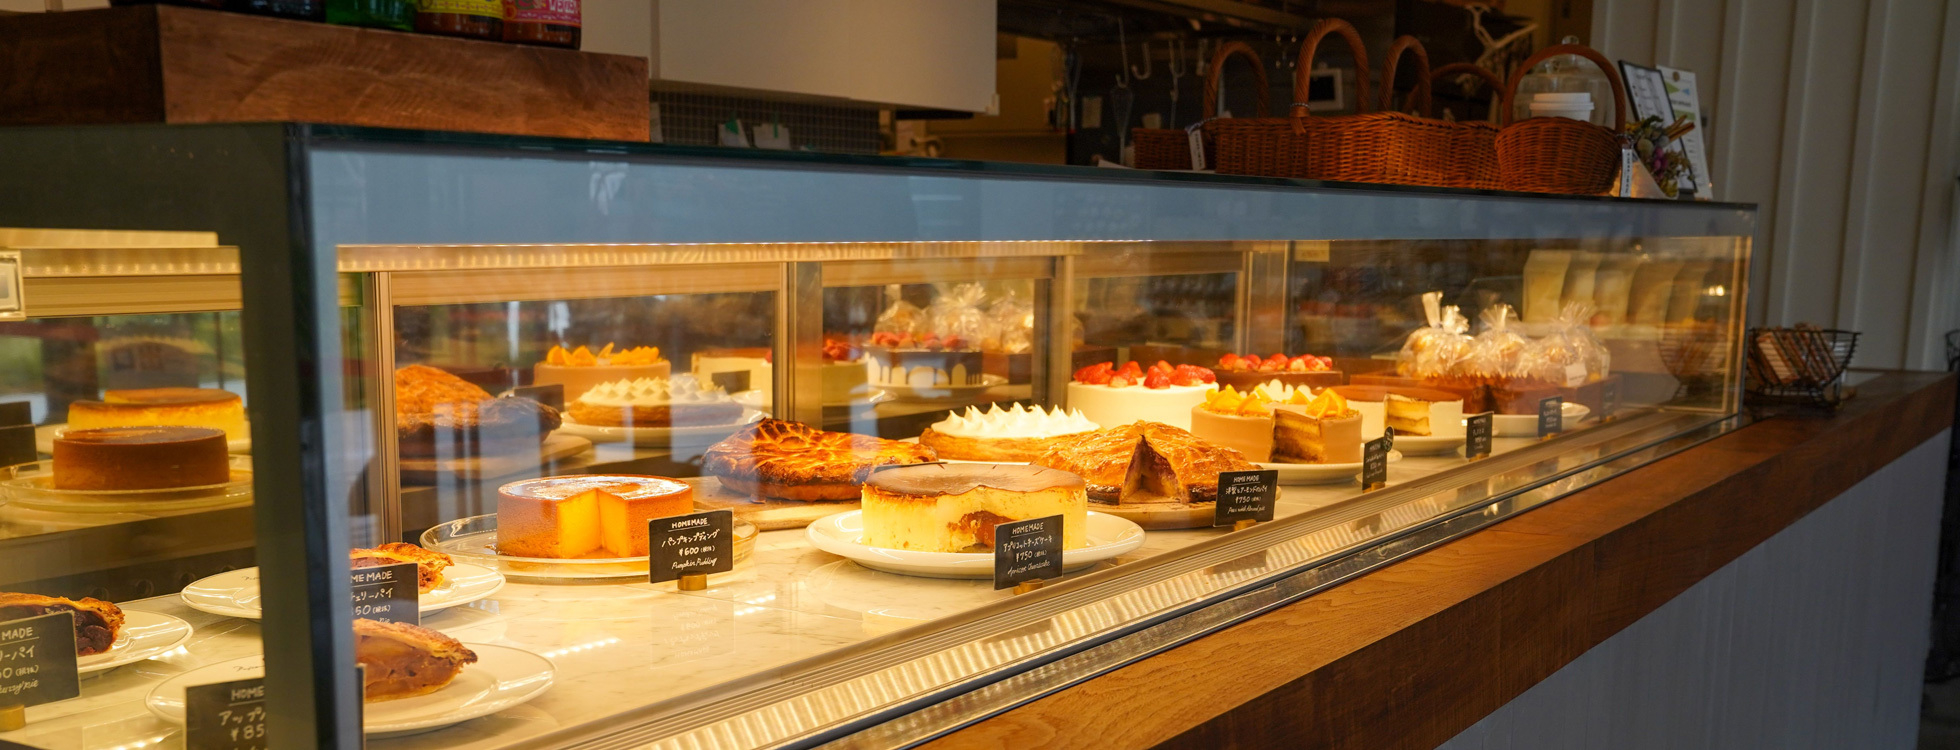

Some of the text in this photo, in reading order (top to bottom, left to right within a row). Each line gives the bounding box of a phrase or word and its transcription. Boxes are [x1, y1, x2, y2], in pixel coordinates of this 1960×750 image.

[678, 546, 699, 557] ¥600
[1015, 550, 1033, 563] ¥750
[366, 570, 393, 582] MADE
[1, 626, 34, 641] MADE
[231, 685, 265, 701] HOME
